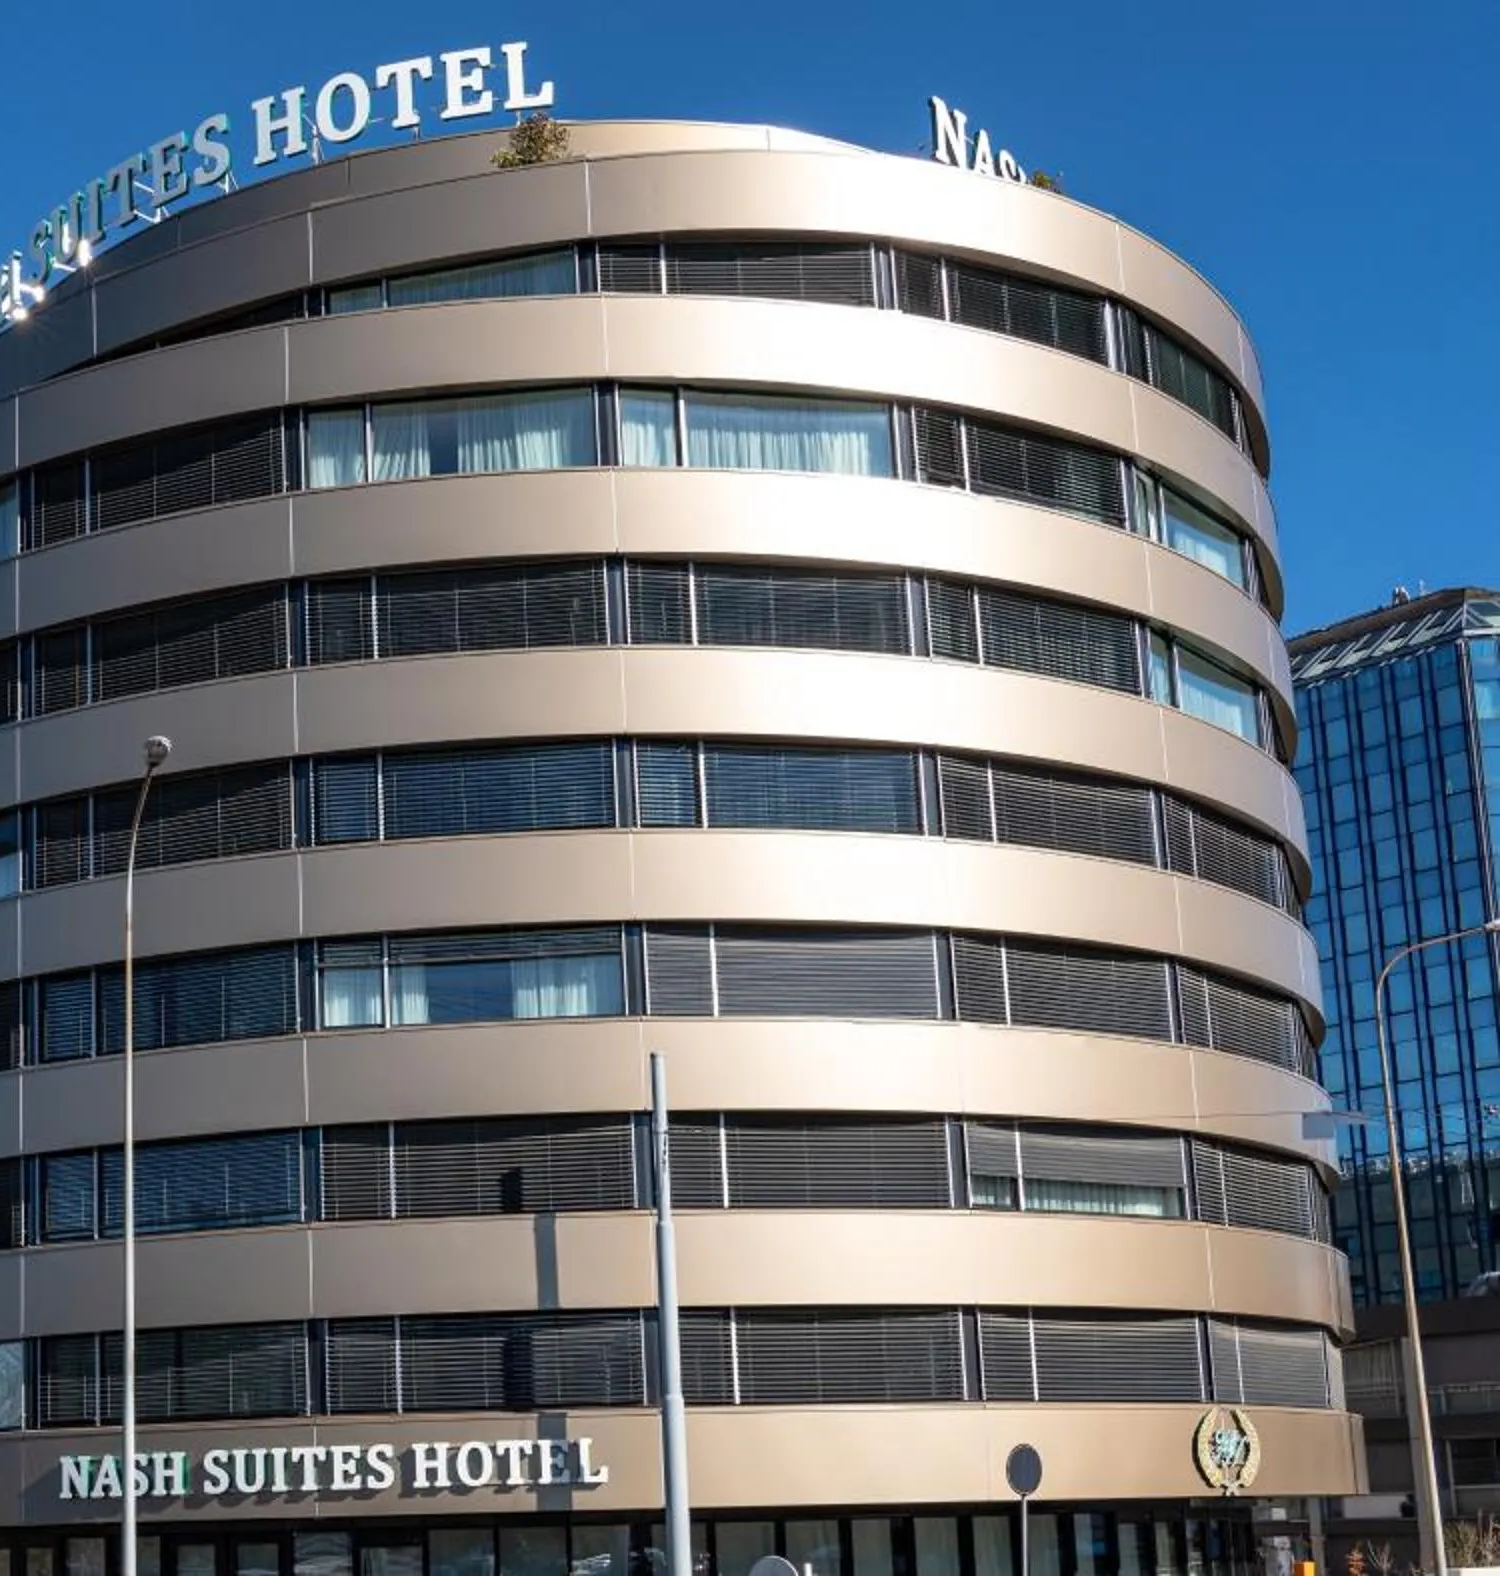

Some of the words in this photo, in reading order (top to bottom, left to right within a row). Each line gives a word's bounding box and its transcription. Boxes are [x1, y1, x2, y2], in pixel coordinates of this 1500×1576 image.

[29, 113, 232, 288] SUITES
[251, 41, 555, 166] HOTEL
[60, 1451, 192, 1499] NASH
[203, 1443, 395, 1496] SUITES
[411, 1437, 609, 1488] HOTEL
